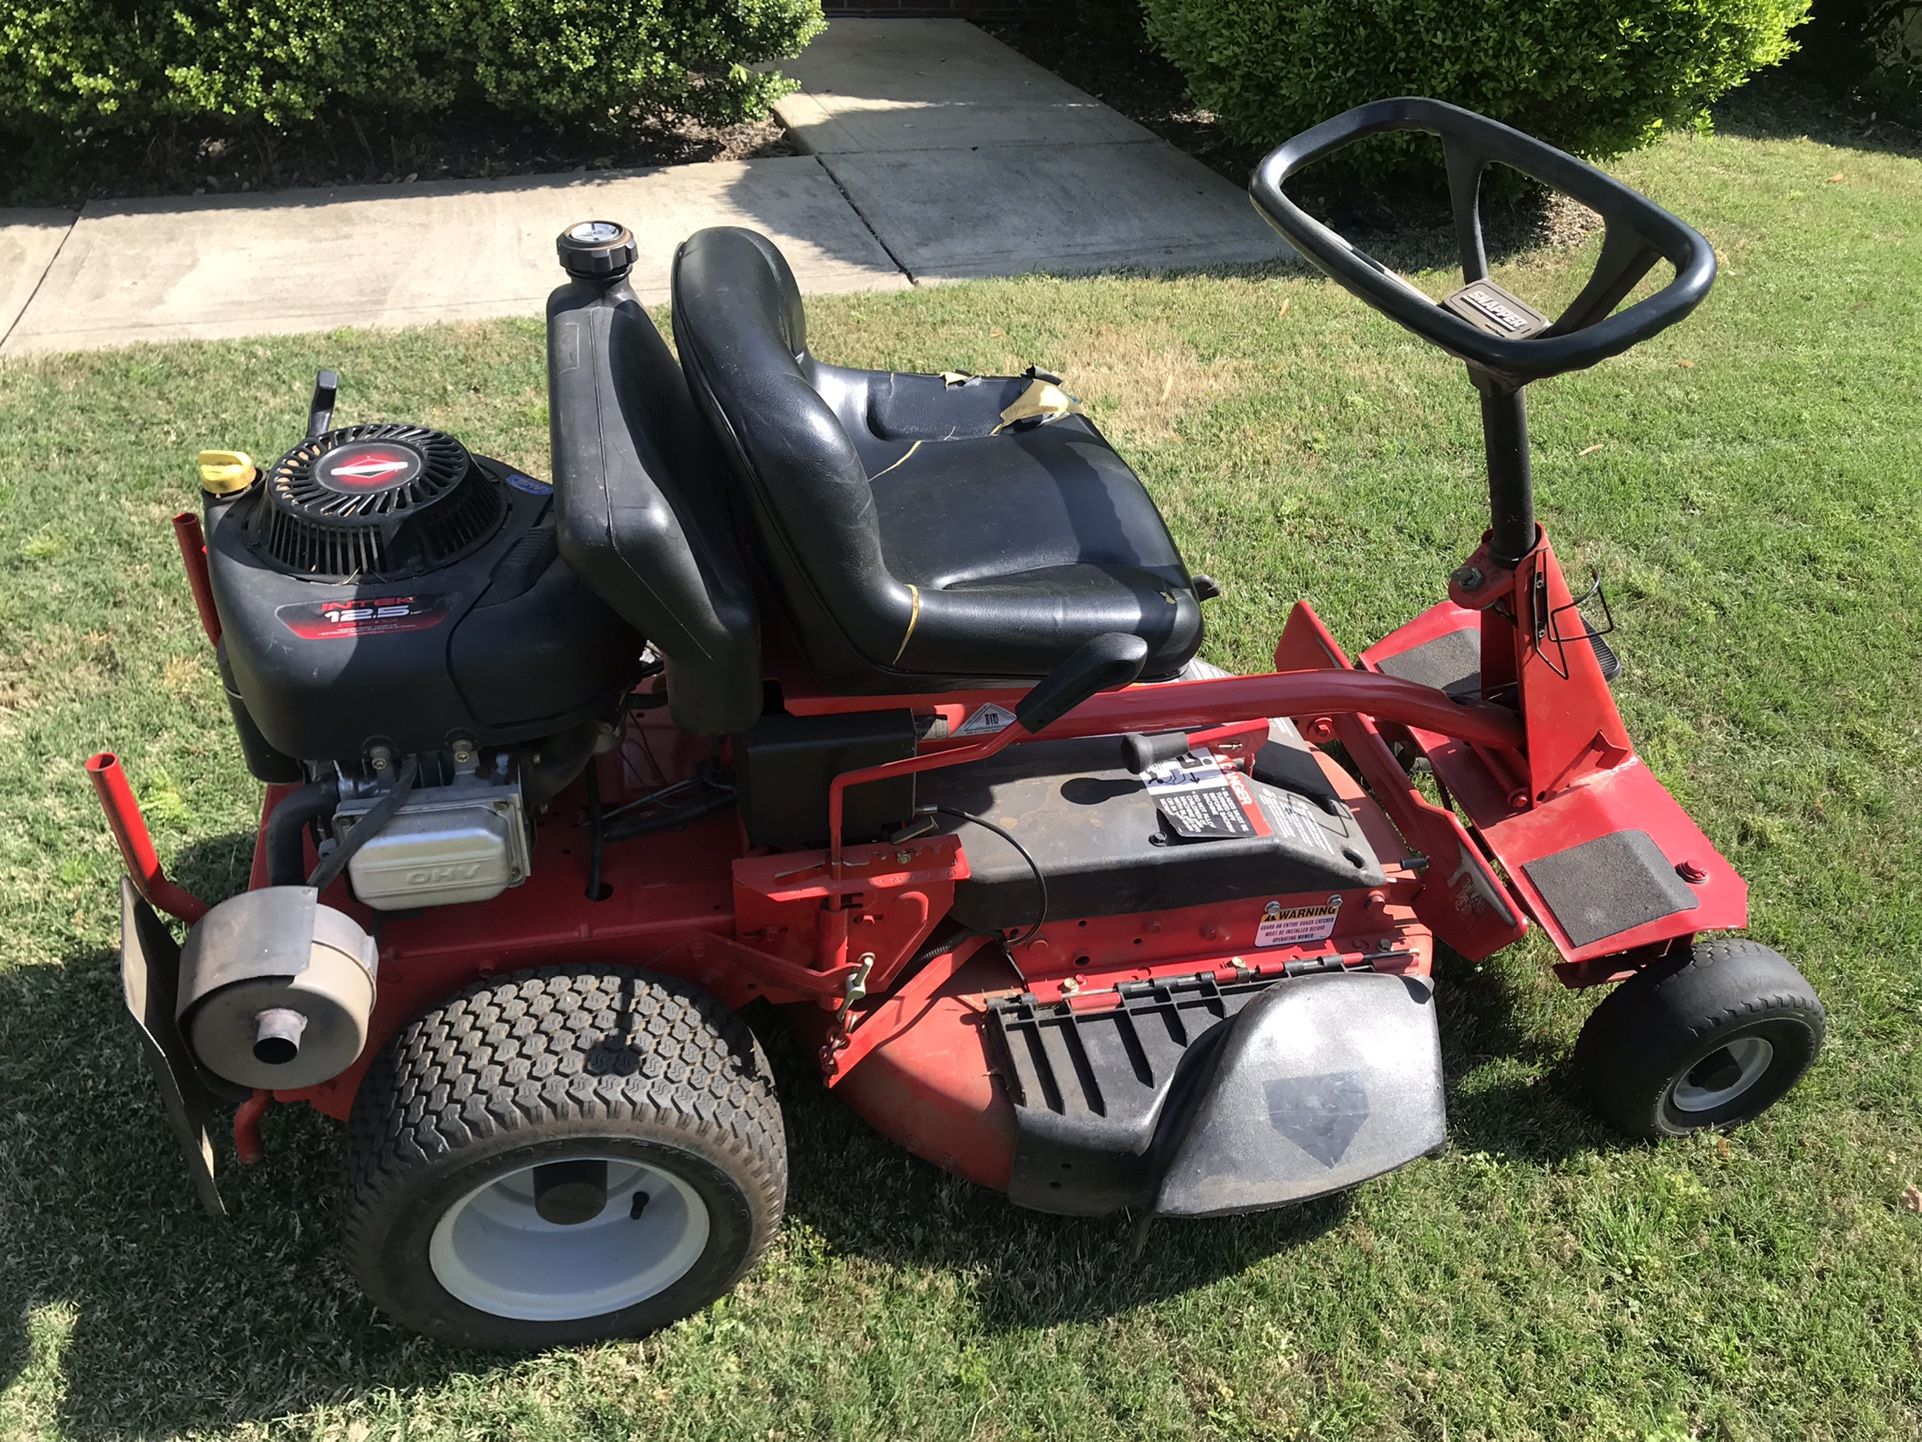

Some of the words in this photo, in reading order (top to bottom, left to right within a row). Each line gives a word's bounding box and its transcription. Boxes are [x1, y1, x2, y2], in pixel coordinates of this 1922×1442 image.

[1468, 291, 1528, 328] SNAPPER
[322, 597, 414, 612] INTEK
[324, 605, 410, 623] 12.5
[1218, 762, 1252, 805] DANGER
[1193, 794, 1201, 802] DO
[1197, 802, 1207, 813] NOT
[1202, 793, 1218, 815] MACHINE
[1209, 792, 1224, 812] BEFORE
[1216, 792, 1230, 812] TURNED
[1227, 811, 1237, 822] OFF
[1222, 791, 1237, 810] BLADES
[1233, 810, 1245, 824] MUST
[1241, 824, 1249, 832] BE
[406, 864, 480, 884] OHV
[1280, 906, 1336, 920] WARNING
[1315, 917, 1335, 925] CATCHER
[1272, 935, 1297, 943] OPERATING
[1285, 927, 1309, 935] INSTALLED
